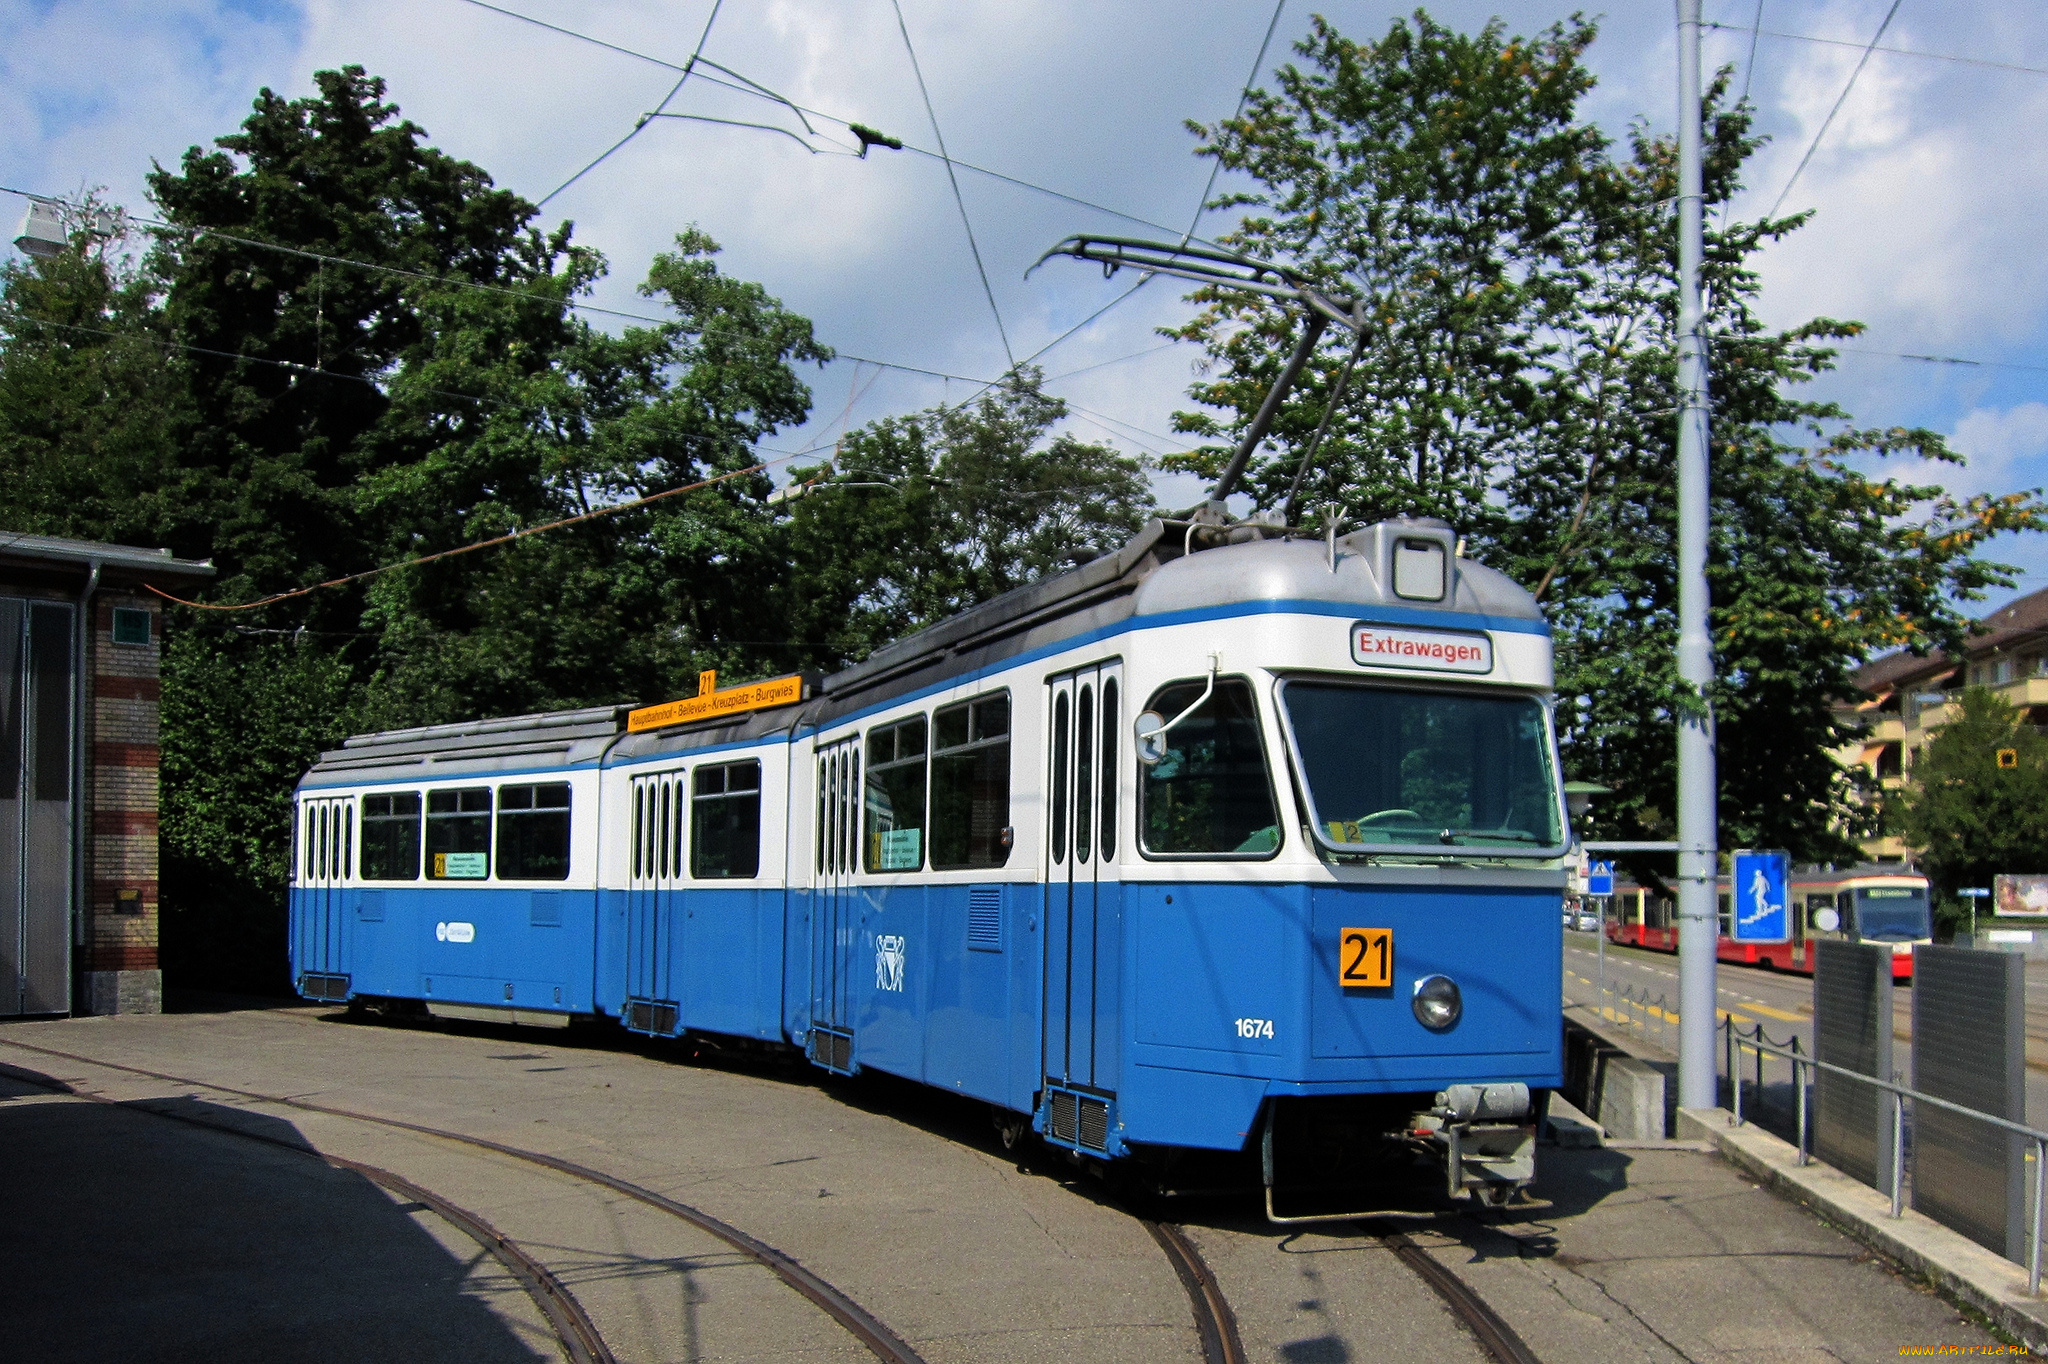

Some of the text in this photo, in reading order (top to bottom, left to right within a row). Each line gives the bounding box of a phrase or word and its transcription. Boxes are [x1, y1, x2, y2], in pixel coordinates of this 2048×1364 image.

[1360, 633, 1482, 663] Extrawagen
[700, 674, 711, 695] 21
[631, 705, 673, 726] Hauptbahnhof
[677, 703, 707, 717] Bellevue
[711, 692, 749, 710] Kreuzplatz
[755, 684, 794, 702] Burgwies
[1343, 933, 1388, 981] 21
[1235, 1018, 1275, 1039] 1674
